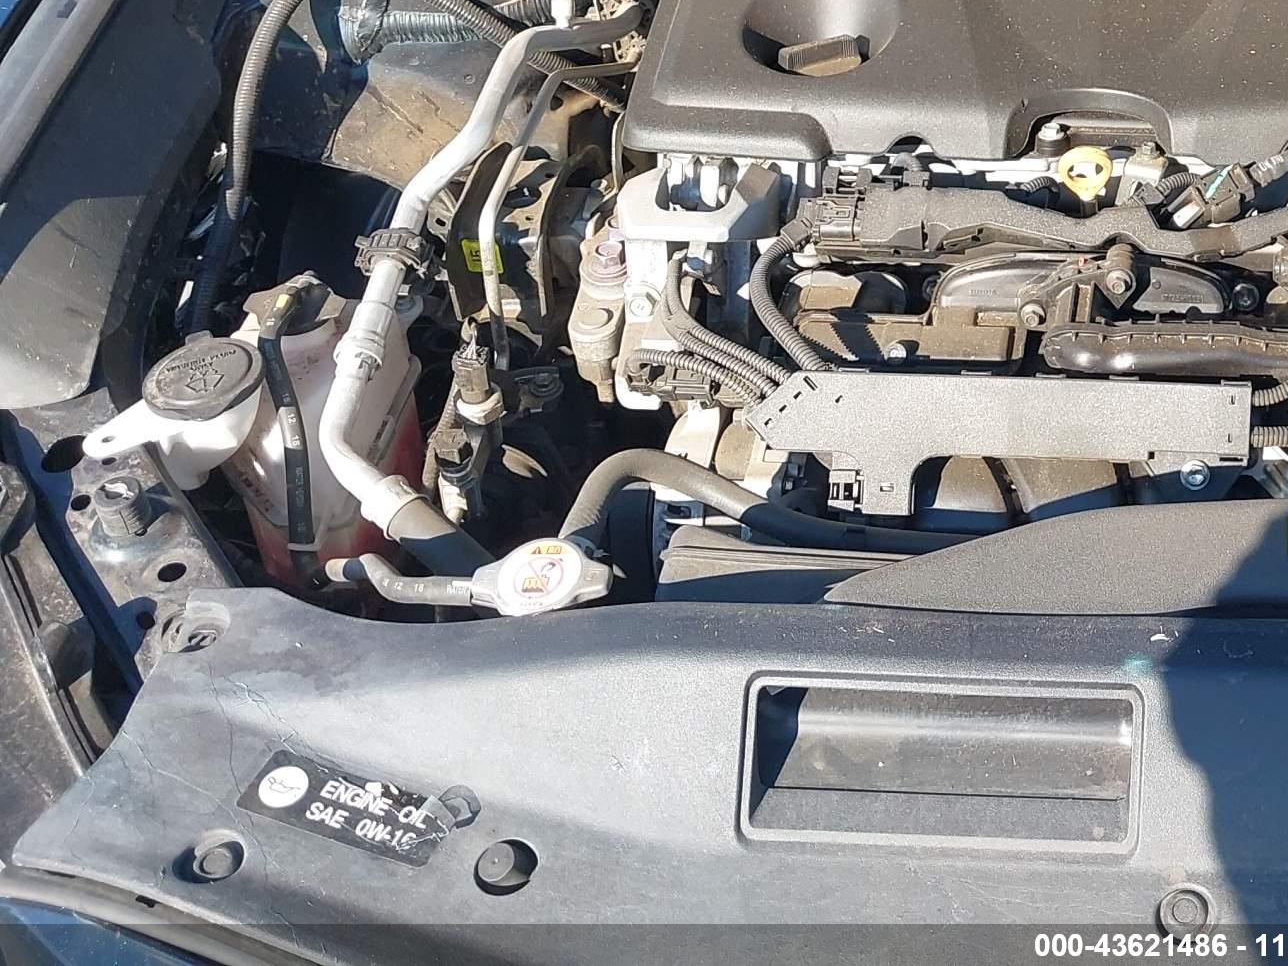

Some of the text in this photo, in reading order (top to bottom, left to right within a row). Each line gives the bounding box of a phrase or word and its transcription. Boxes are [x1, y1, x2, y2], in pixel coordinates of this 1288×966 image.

[305, 801, 349, 829] SAE
[320, 779, 427, 829] ENGINE OIL
